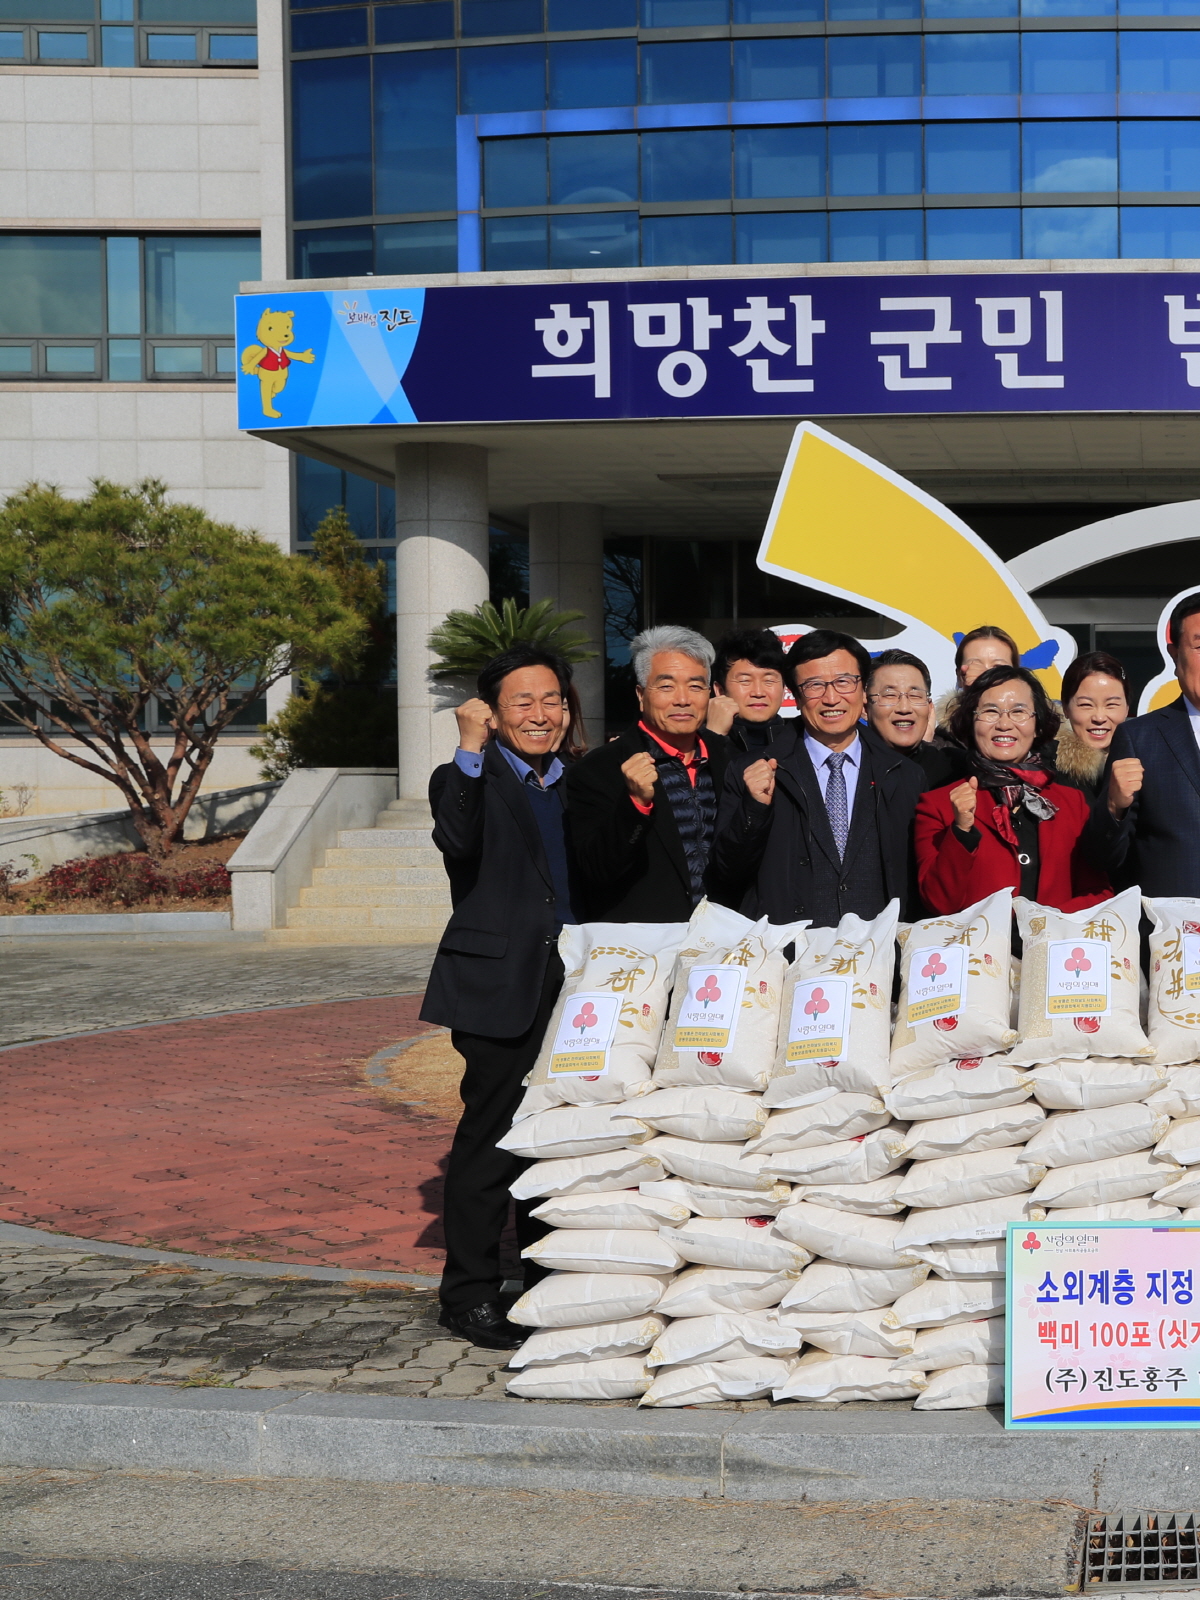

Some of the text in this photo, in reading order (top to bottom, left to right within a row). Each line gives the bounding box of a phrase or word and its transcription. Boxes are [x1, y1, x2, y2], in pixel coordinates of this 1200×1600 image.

[346, 308, 417, 331] 보배섬 진도
[531, 294, 826, 398] 희망찬
[870, 289, 1065, 391] 군민
[1044, 1233, 1099, 1247] 사랑의 열매
[1036, 1268, 1136, 1306] 소외계층
[1146, 1268, 1194, 1305] 지정
[1038, 1320, 1079, 1349] 백미
